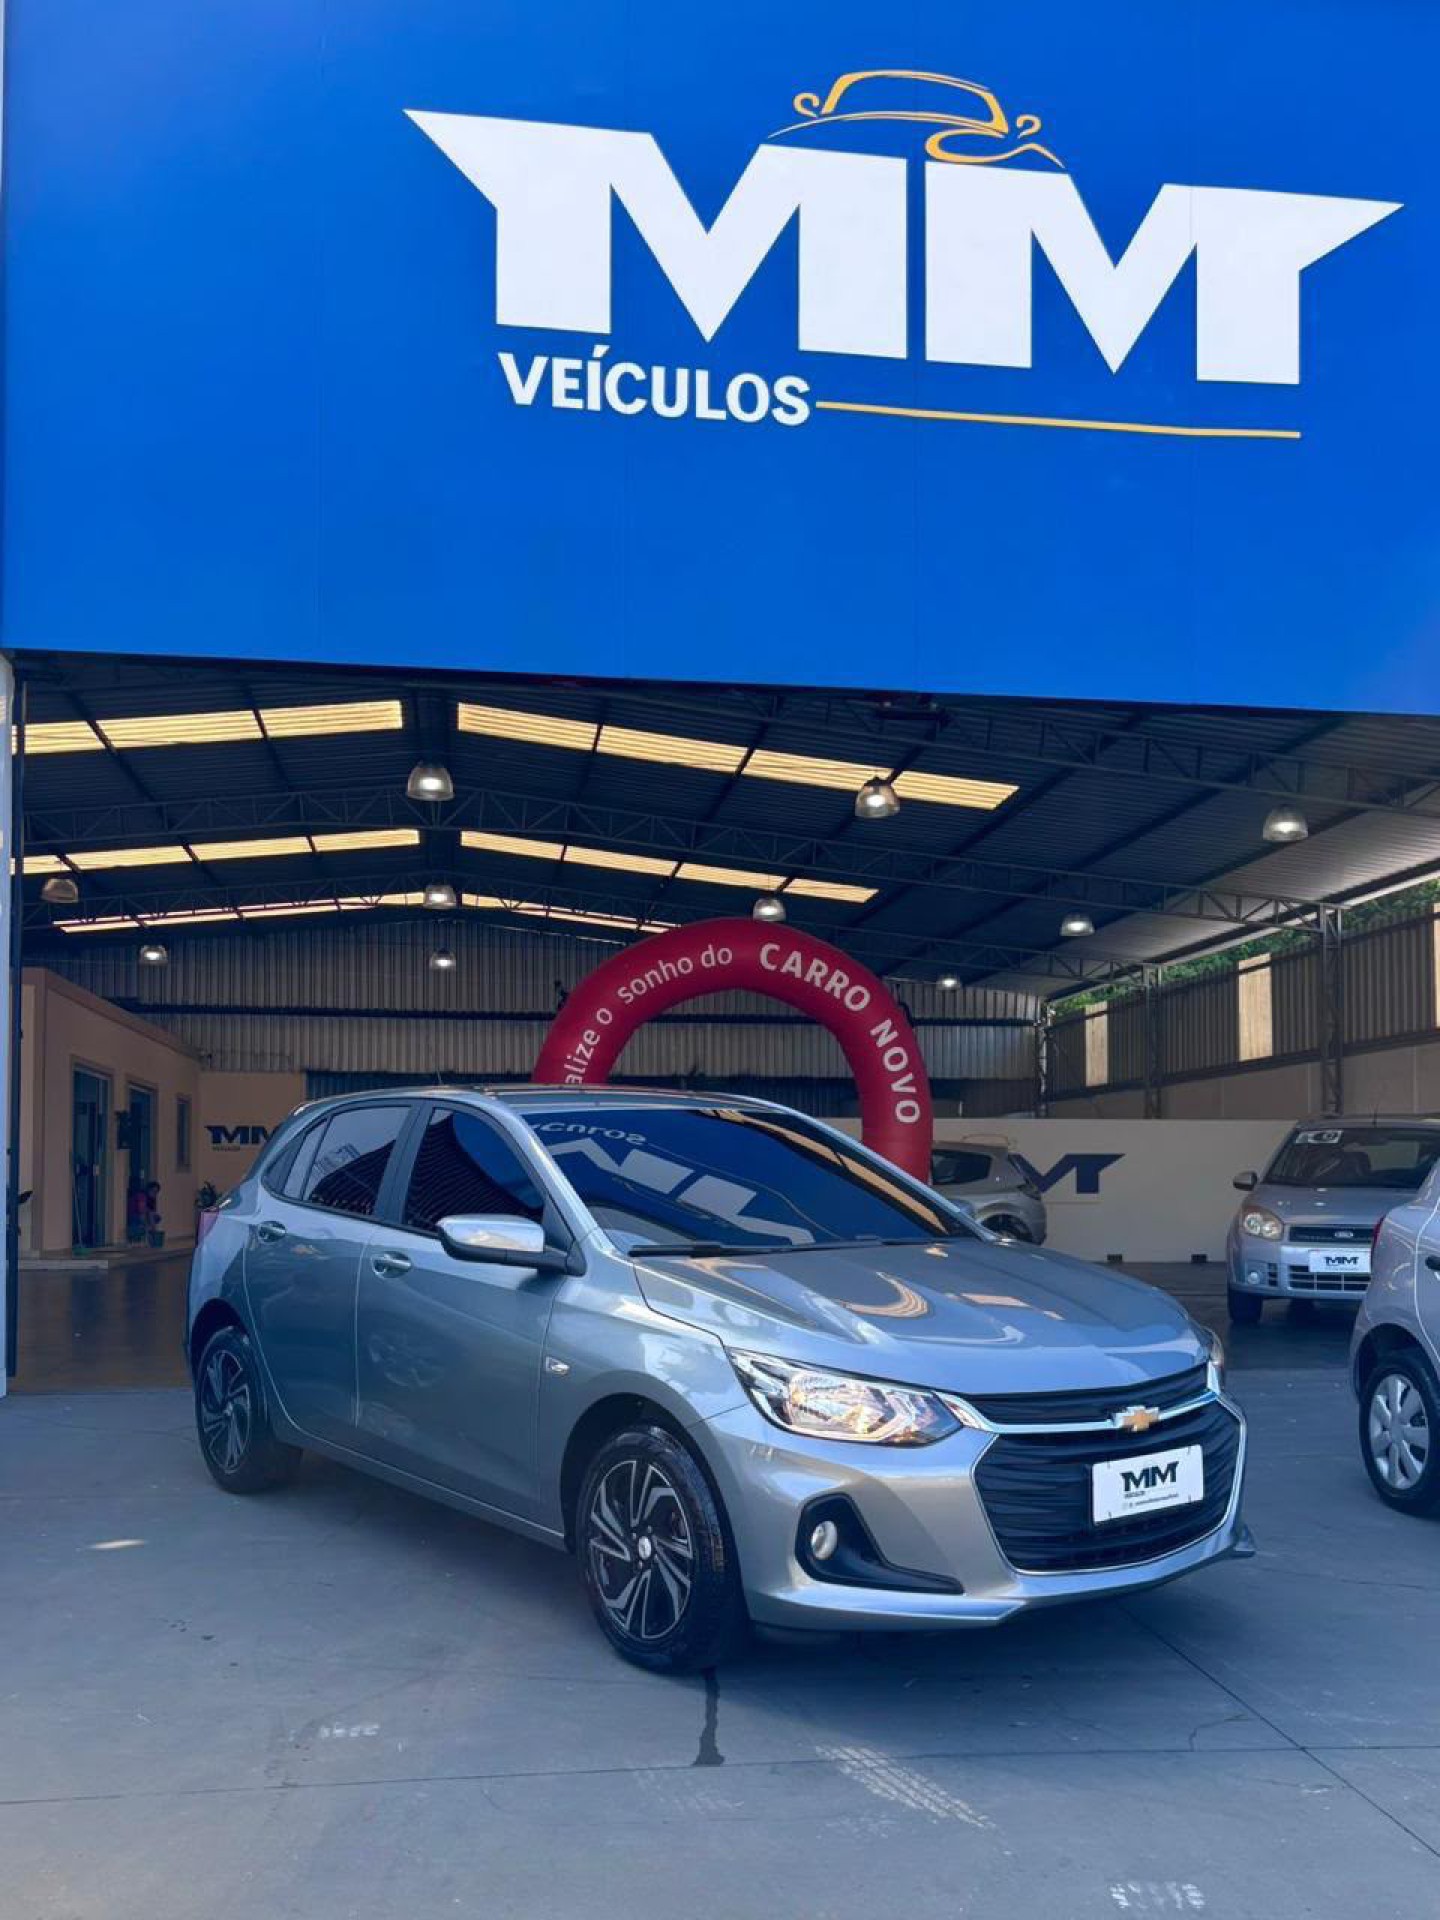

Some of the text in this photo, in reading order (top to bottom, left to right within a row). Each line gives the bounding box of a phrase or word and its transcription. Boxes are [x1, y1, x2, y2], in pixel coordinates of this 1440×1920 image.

[403, 108, 1404, 385] MM
[497, 344, 812, 427] VEÍCULOS
[563, 942, 921, 1124] alize o sonho do CARRO NOVO
[1119, 1460, 1180, 1492] MM
